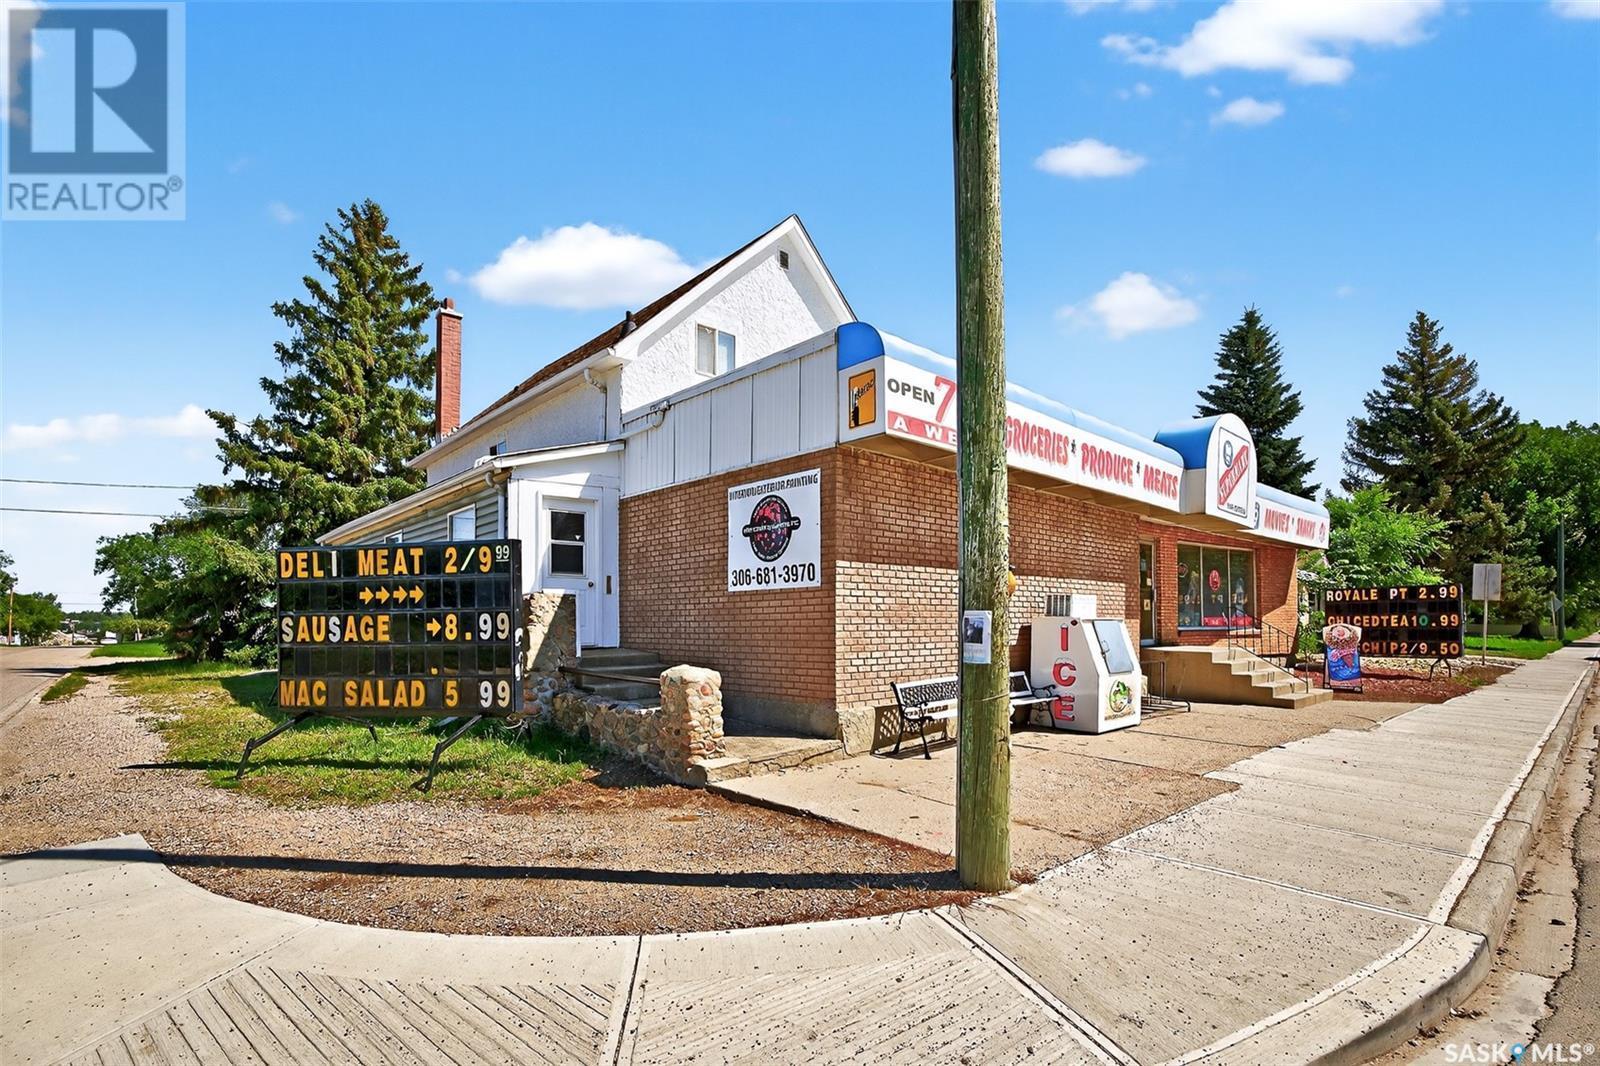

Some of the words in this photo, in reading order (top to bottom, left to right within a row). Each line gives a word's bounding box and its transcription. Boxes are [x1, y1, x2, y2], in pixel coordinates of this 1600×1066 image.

[887, 378, 935, 405] OPEN
[934, 375, 957, 424] 7
[893, 416, 909, 432] A
[925, 424, 957, 443] WE
[1005, 415, 1070, 466] GROCERIES
[1081, 442, 1134, 486] PRODUCE
[1143, 464, 1178, 499] MEATS
[280, 550, 338, 579] DELI
[358, 547, 424, 576] MEAT
[732, 562, 816, 587] 306-681-3970
[1326, 588, 1378, 602] ROYALE
[1389, 587, 1408, 600] PT
[1418, 585, 1459, 600] 2.99
[281, 614, 391, 643] SAUSAGE
[445, 612, 510, 641] 8.99
[1053, 624, 1077, 721] ICE
[280, 679, 327, 706] MAC
[345, 679, 426, 708] SALAD
